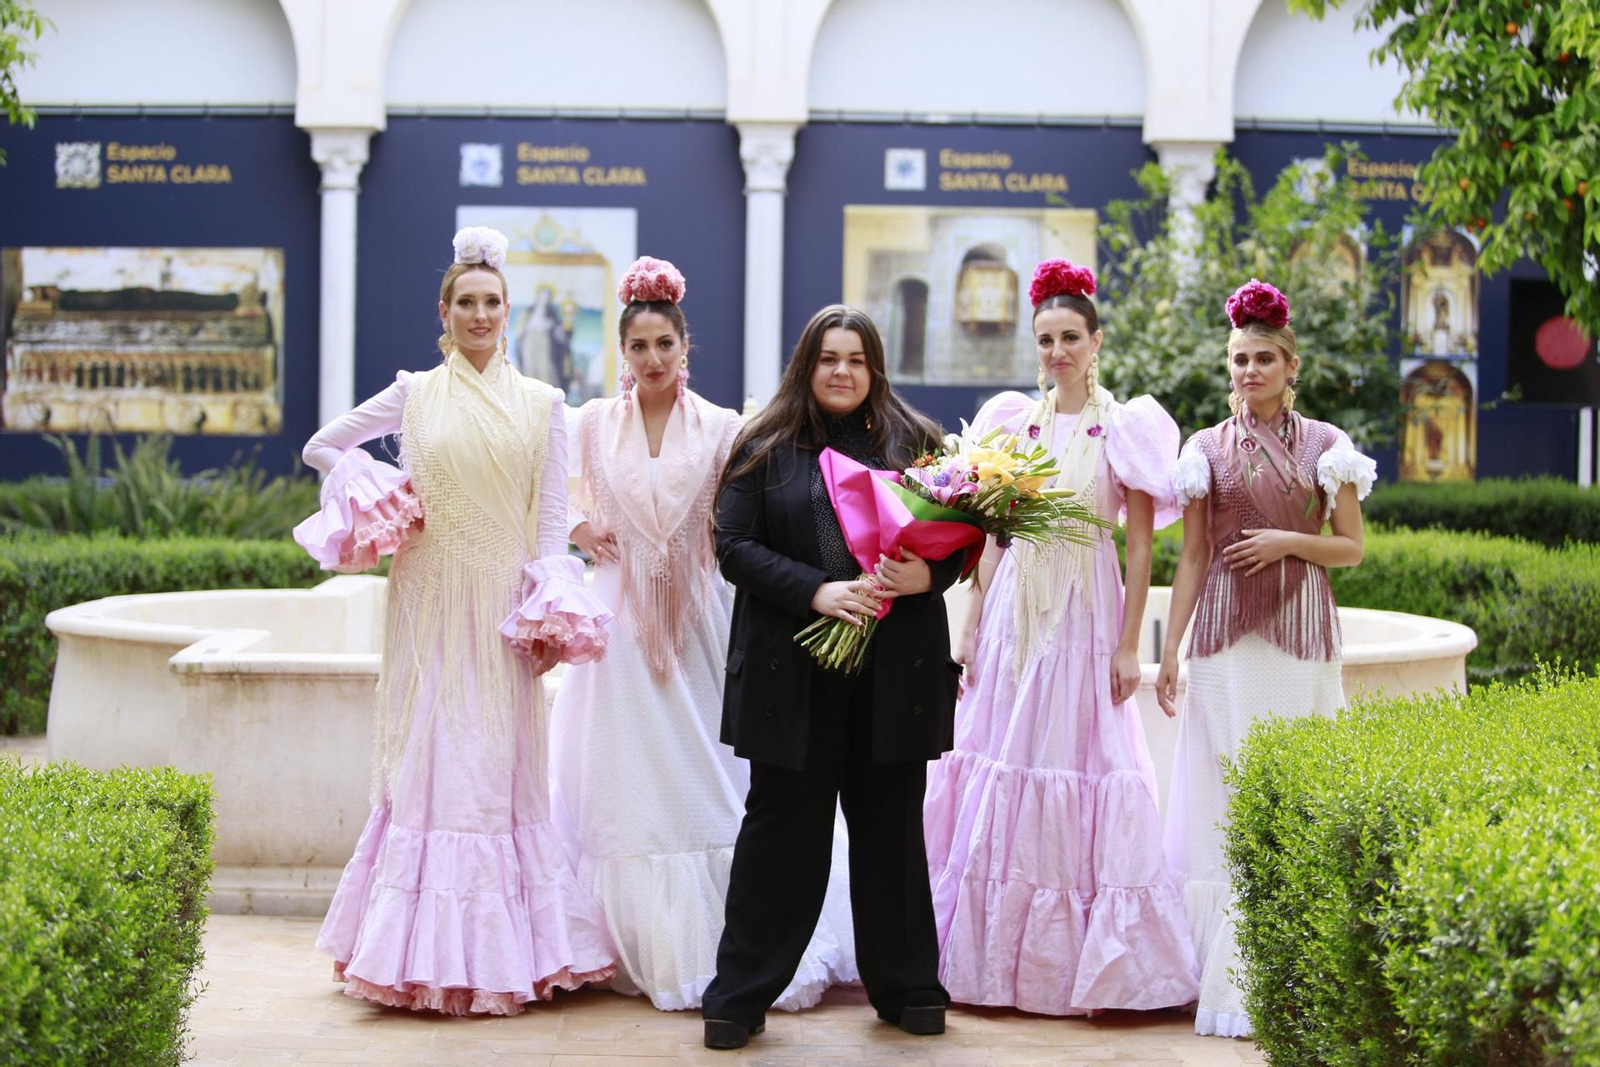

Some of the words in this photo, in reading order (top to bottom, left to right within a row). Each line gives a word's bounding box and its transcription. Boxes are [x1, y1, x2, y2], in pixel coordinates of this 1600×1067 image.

[107, 142, 175, 162] Espacio
[517, 142, 589, 163] Espacio
[940, 149, 1011, 169] Espacio
[107, 165, 166, 183] SANTA
[170, 165, 231, 183] CLARA
[517, 166, 579, 185] SANTA
[583, 166, 645, 186] CLARA
[939, 172, 1001, 191] SANTA
[1005, 173, 1066, 192] CLARA
